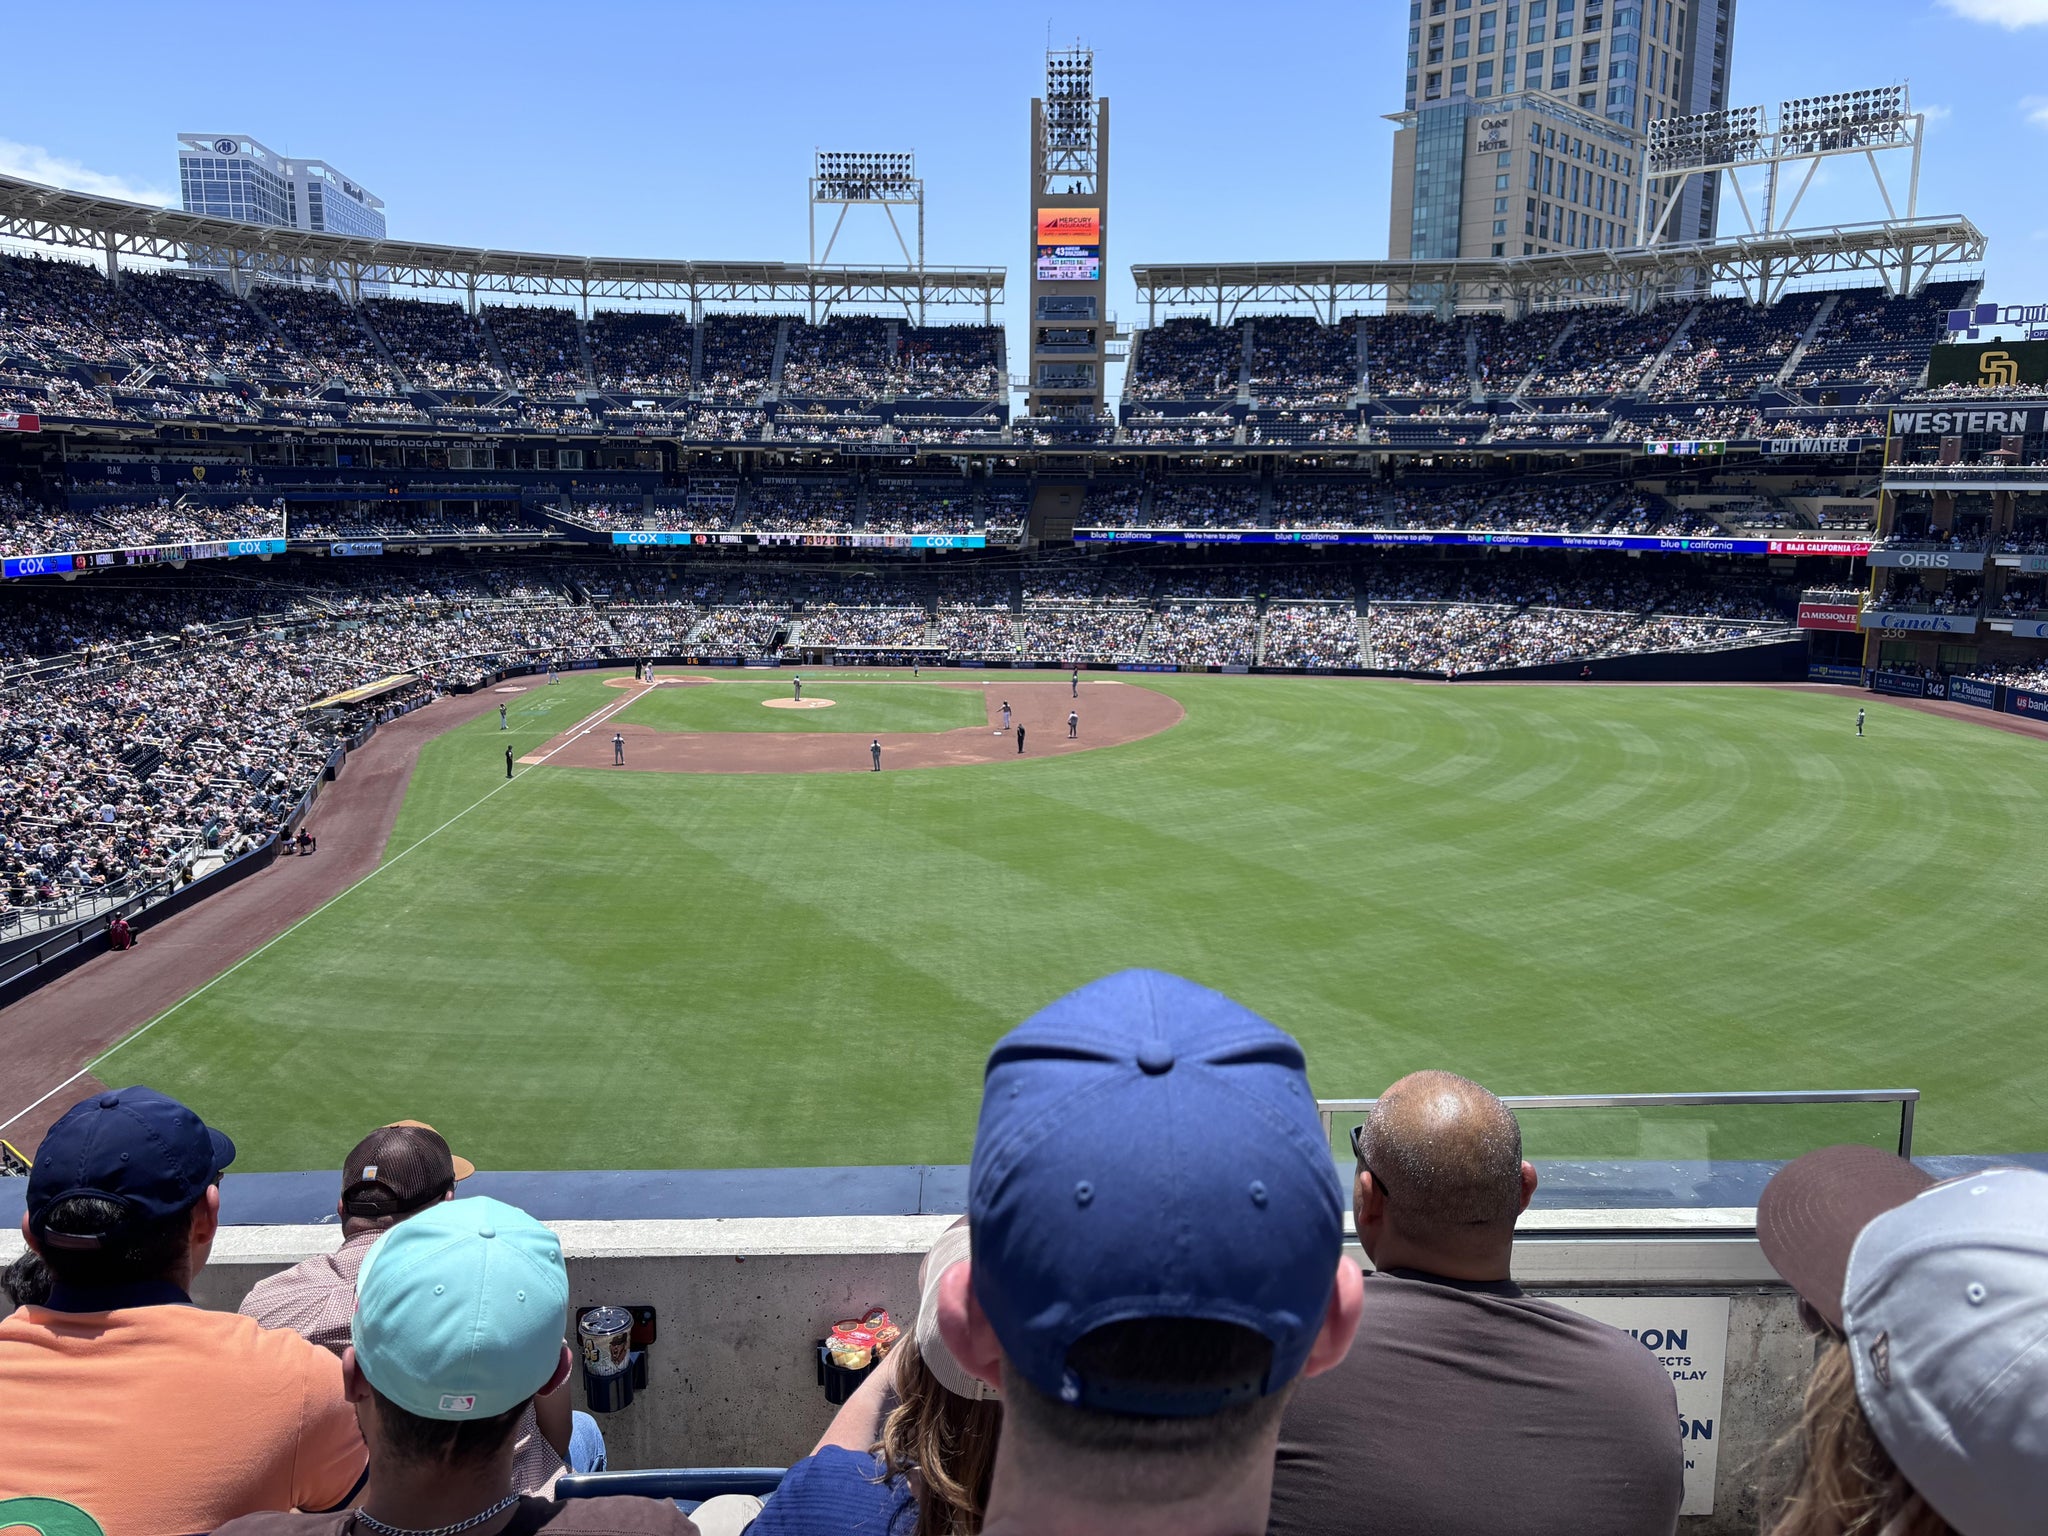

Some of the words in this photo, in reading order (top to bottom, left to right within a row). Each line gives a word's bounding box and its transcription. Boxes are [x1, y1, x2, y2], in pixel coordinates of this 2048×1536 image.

[1481, 119, 1508, 131] OMNI
[1477, 140, 1509, 153] HOTEL
[1055, 247, 1065, 256] 43
[1893, 411, 2029, 433] WESTERN
[268, 436, 306, 444] JERRY
[311, 437, 370, 446] COLEMAN
[374, 439, 449, 448] BROADCAST
[453, 441, 500, 449] CENTER
[1770, 439, 1849, 453] CUTWATER
[848, 444, 858, 453] UC
[858, 444, 871, 453] San
[871, 444, 889, 454] Diego
[889, 445, 910, 454] Health
[107, 466, 122, 475] RAK
[762, 477, 797, 485] CUTWATER
[878, 478, 913, 486] CUTWATER
[629, 533, 658, 543] COX
[712, 535, 717, 543] 3
[720, 535, 743, 544] MERRILL
[926, 537, 954, 547] COX
[1301, 533, 1339, 541] california
[1467, 534, 1484, 542] blue
[1492, 535, 1529, 543] california
[239, 542, 261, 553] COX
[1608, 539, 1624, 547] play
[1660, 540, 1680, 548] blue
[1690, 541, 1733, 550] california
[1786, 543, 1805, 551] BAJA
[1807, 543, 1851, 552] CALIFORNIA
[96, 554, 115, 565] MERRILL
[1899, 553, 1949, 567] ORIS
[19, 558, 45, 574] COX
[1811, 612, 1846, 620] MISSION
[1881, 614, 1952, 631] Canel's
[1927, 682, 1945, 697] 342
[1961, 682, 1993, 698] Palomar
[1951, 691, 1971, 700] SPECIALTY
[1970, 695, 1992, 705] INSURANCE
[2028, 698, 2048, 713] bank
[1672, 1371, 1708, 1381] PLAY
